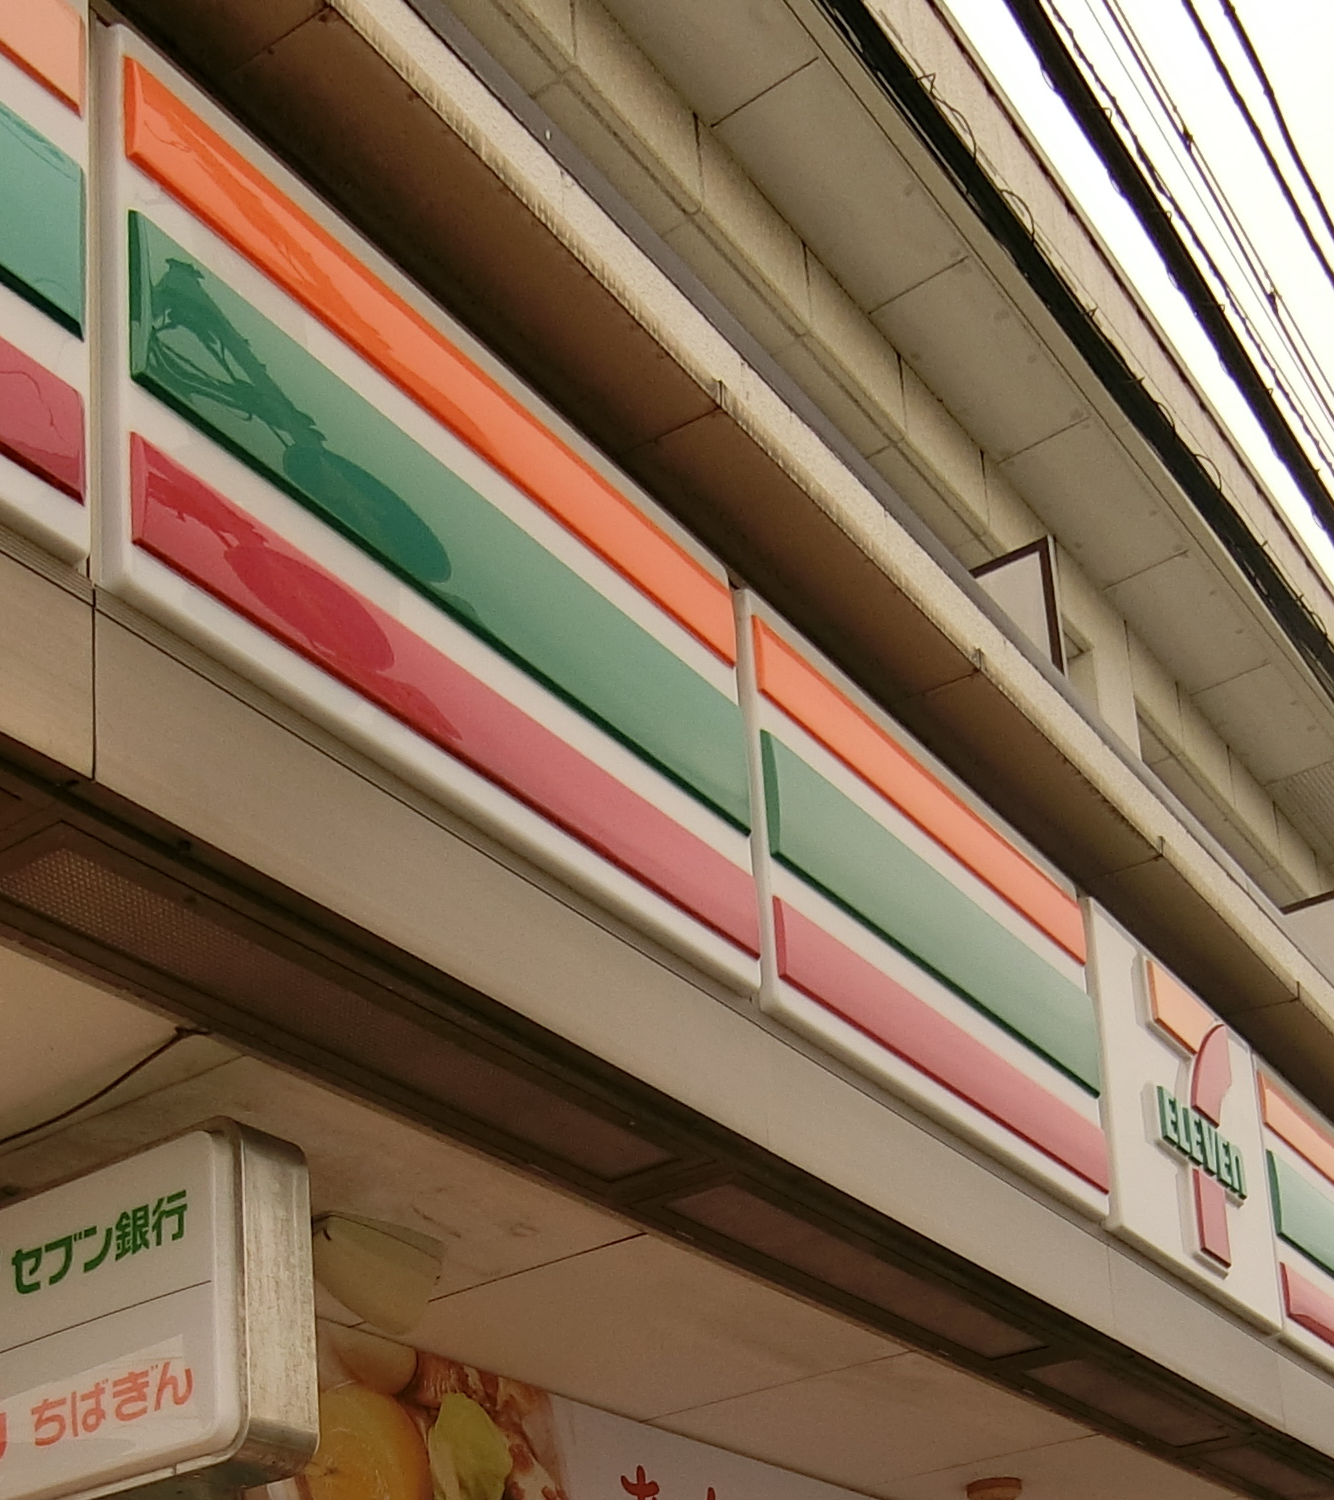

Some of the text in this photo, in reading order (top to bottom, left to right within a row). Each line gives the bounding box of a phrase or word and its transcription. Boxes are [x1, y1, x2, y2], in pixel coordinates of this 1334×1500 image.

[12, 1190, 188, 1294] セブン銀行
[31, 1361, 193, 1447] ちばぎん
